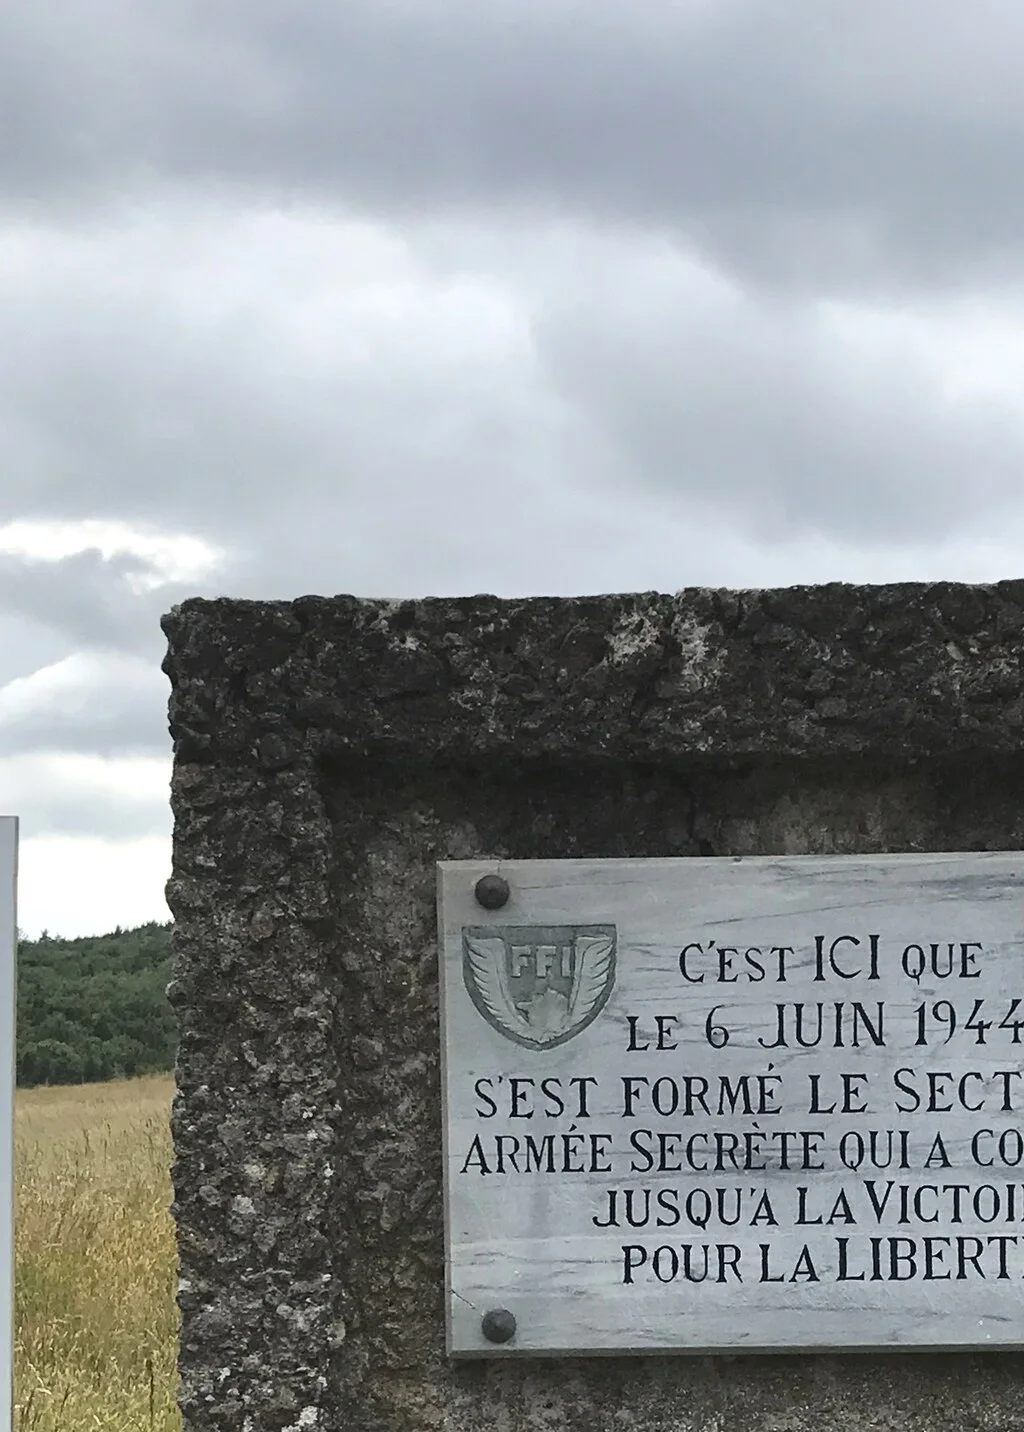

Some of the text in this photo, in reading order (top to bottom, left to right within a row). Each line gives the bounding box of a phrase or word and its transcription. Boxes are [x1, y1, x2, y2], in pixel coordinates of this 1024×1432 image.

[511, 945, 571, 979] FFI
[679, 934, 984, 985] C'EST ICI QUE
[626, 1016, 679, 1051] LE
[705, 1004, 730, 1049] 6
[757, 1000, 886, 1049] JUIN
[474, 1076, 599, 1119] S'EST
[621, 1063, 784, 1118] FORMÉ
[808, 1073, 869, 1114] LE
[459, 1124, 613, 1176] ARMÉE
[630, 1122, 826, 1173] SECRÈTE
[840, 1130, 911, 1172] QUI
[924, 1131, 952, 1169] A
[794, 1187, 857, 1226] LA
[621, 1244, 744, 1284] POUR
[759, 1244, 821, 1283] LA
